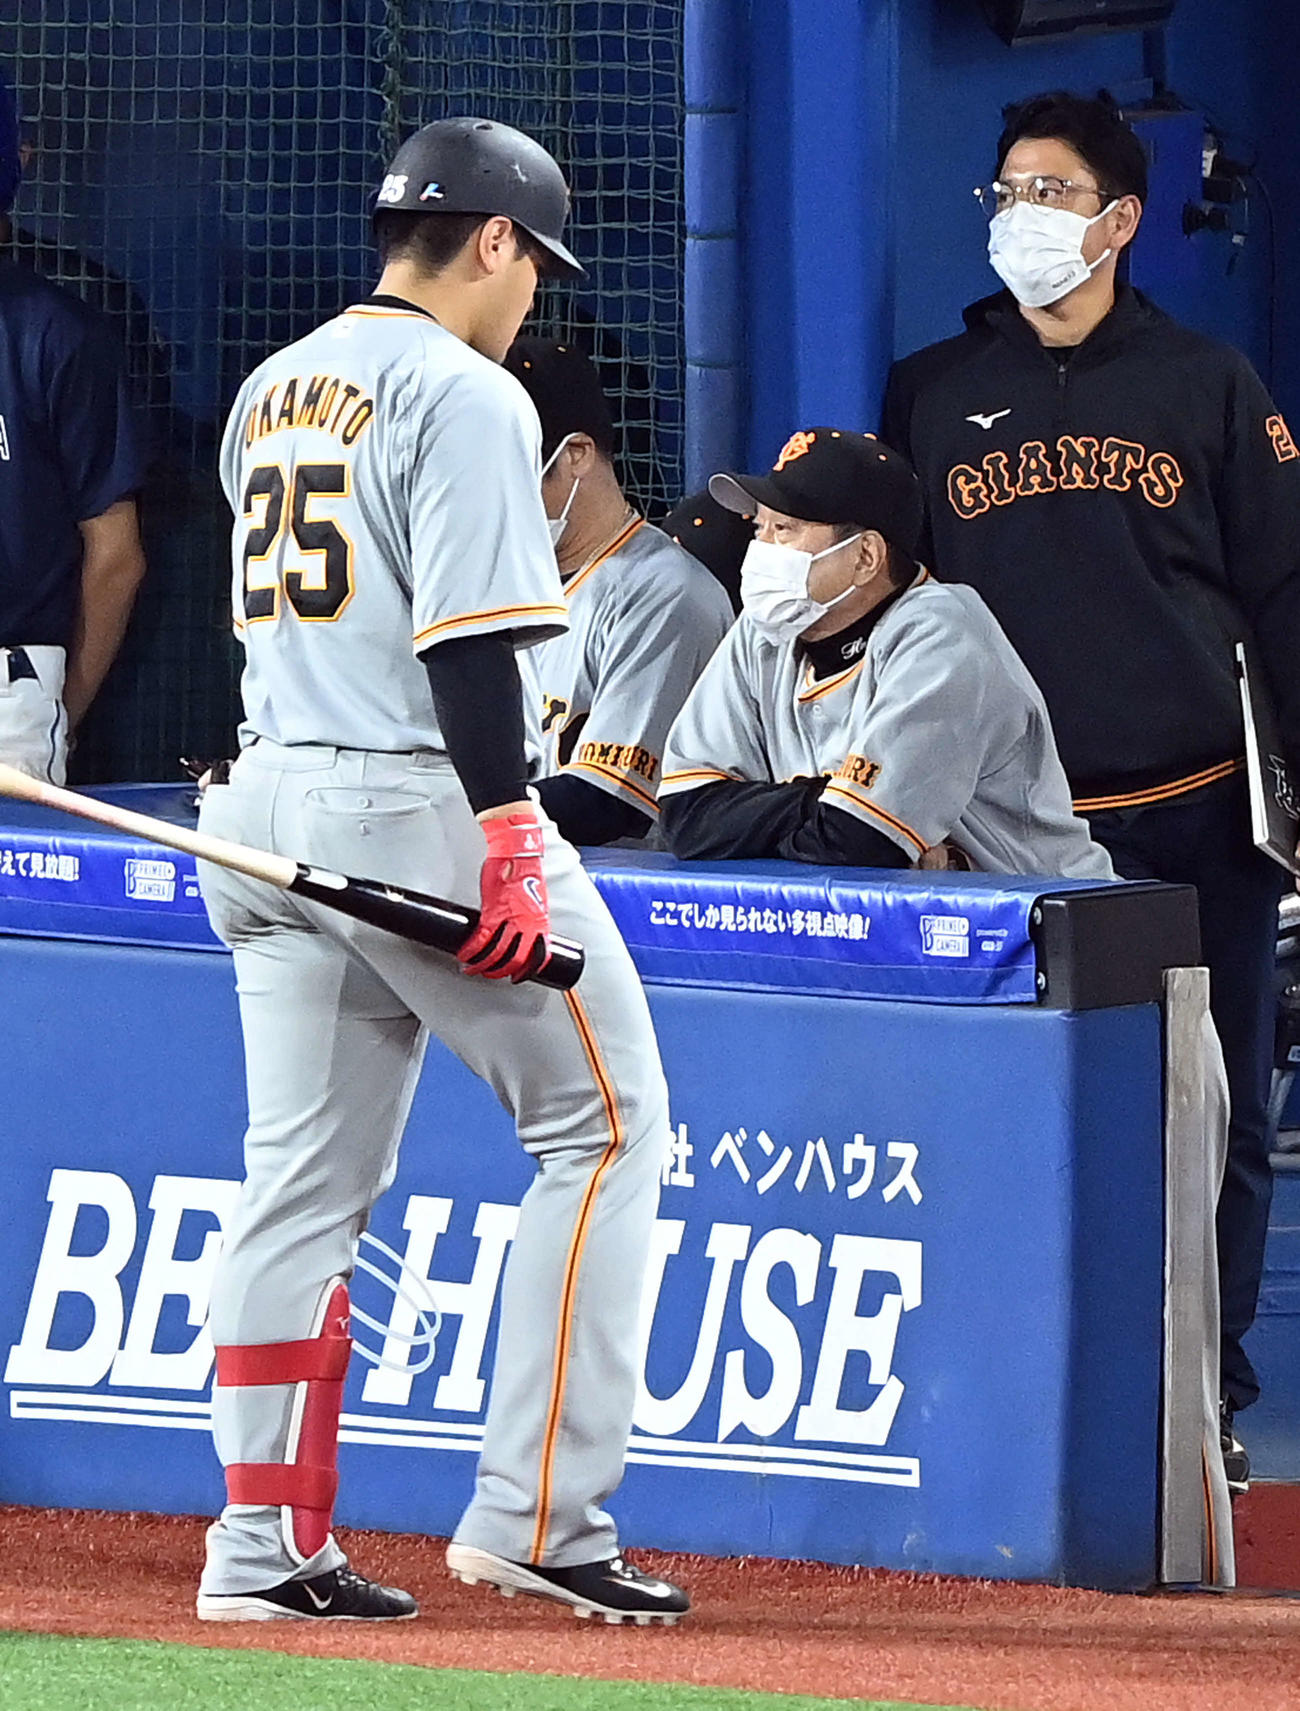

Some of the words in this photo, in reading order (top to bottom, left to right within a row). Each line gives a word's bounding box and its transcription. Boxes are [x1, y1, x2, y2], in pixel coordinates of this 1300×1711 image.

[245, 375, 374, 450] OKAMOTO
[948, 436, 1184, 519] GIANTS
[242, 462, 355, 622] 25
[579, 742, 659, 782] OMIURI
[0, 849, 80, 881] えて見放題!
[650, 901, 870, 940] ここでしか見られない多視点映像!
[710, 1127, 923, 1206] ベンハウス
[361, 1195, 922, 1446] HUSE
